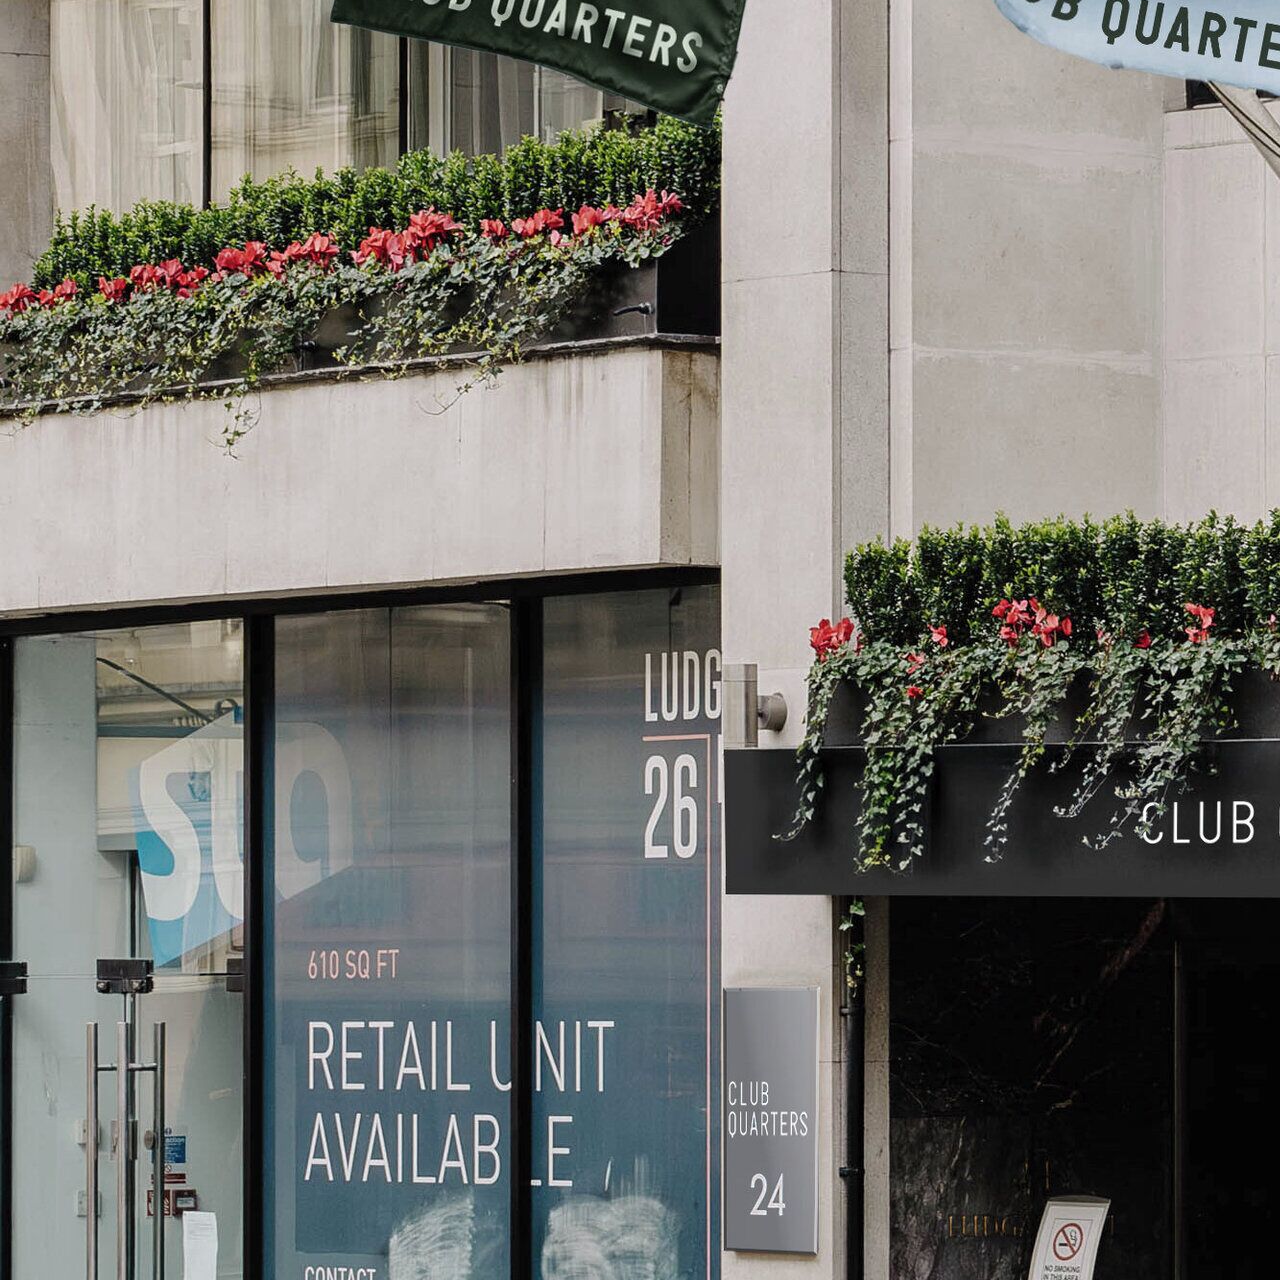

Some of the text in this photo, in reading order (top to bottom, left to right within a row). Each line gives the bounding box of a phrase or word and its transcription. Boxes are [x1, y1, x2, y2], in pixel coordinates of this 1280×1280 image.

[644, 754, 698, 859] 26
[1142, 801, 1255, 844] CLUB
[308, 948, 400, 980] 610 SQ FT
[307, 1020, 470, 1092] RETAIL
[728, 1081, 769, 1106] CLUB
[728, 1111, 808, 1138] QUARTERS
[304, 1112, 573, 1187] AVAILABE
[750, 1173, 786, 1216] 24
